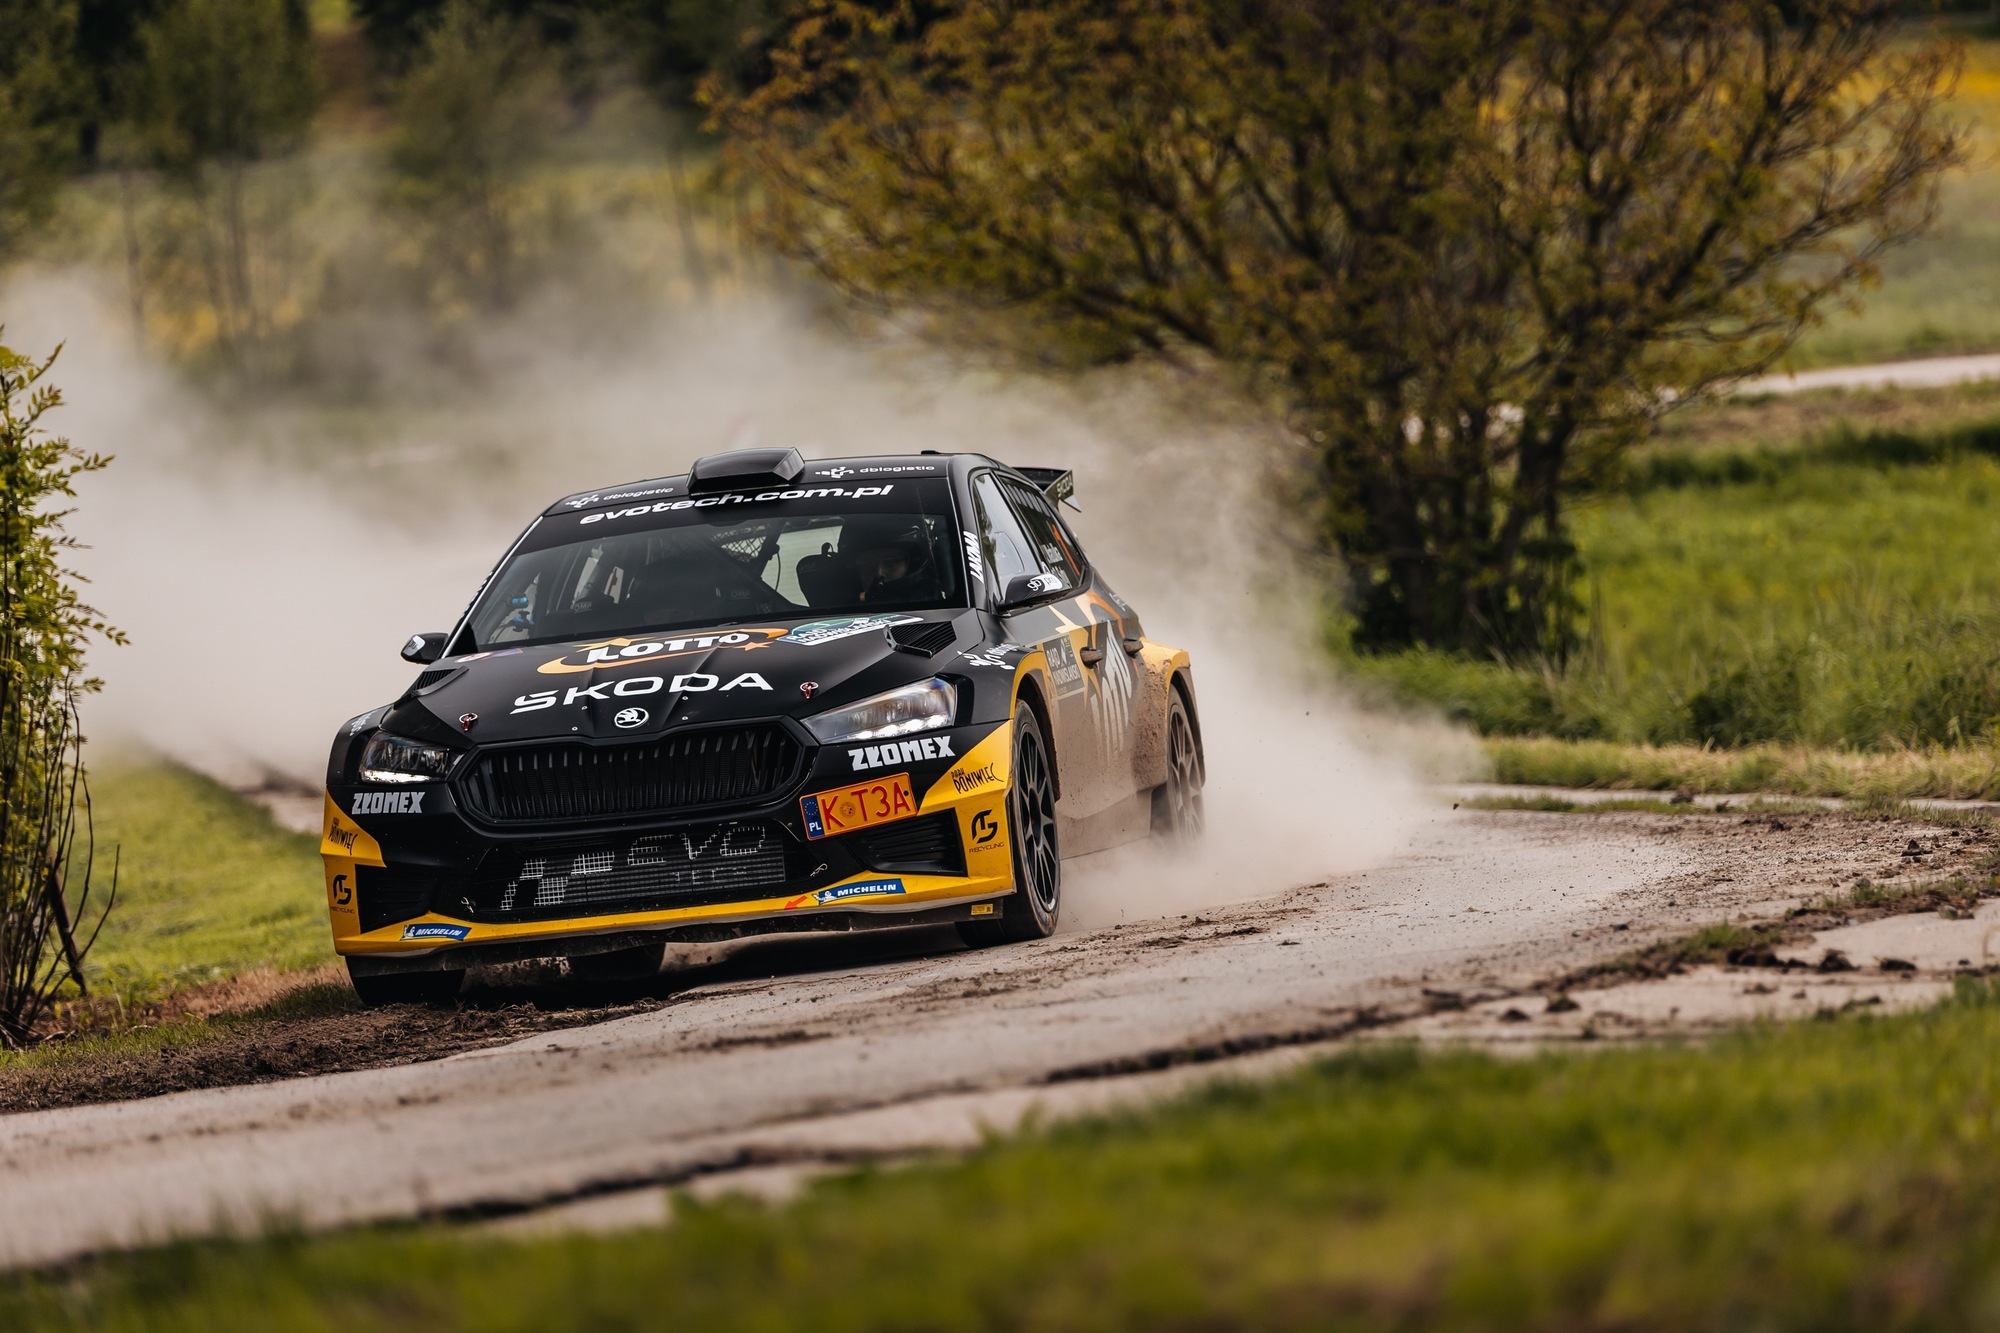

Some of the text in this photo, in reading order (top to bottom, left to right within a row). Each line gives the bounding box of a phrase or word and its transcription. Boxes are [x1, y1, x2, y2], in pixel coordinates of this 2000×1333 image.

[580, 484, 894, 525] evotech.com.pl
[586, 632, 750, 663] LOTTO
[809, 781, 911, 832] PL K T3A
[969, 842, 1005, 854] RECYCLING
[837, 884, 897, 897] MICHELIN
[415, 928, 463, 936] MICHELIN
